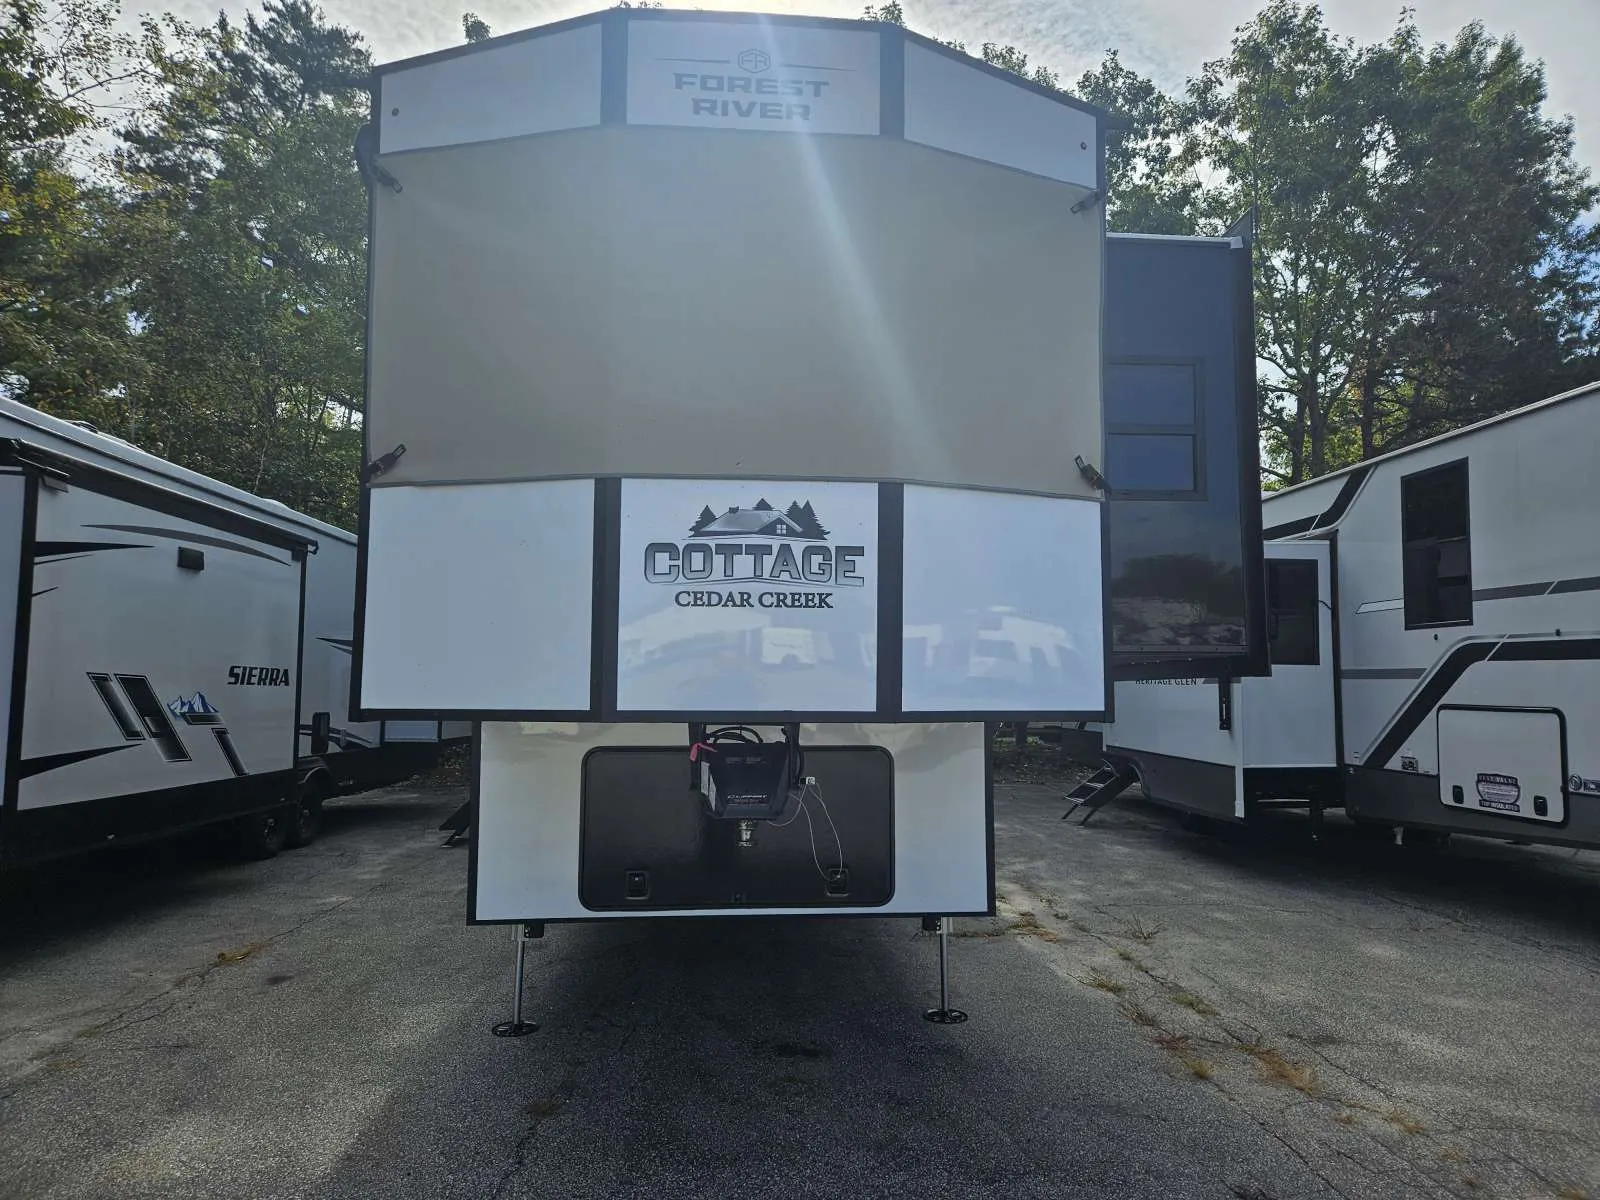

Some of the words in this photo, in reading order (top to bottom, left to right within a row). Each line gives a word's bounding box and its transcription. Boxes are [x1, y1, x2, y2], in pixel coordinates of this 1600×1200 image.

[672, 73, 829, 97] FOREST
[692, 98, 811, 120] RIVER
[644, 542, 865, 587] COTTAGE
[675, 590, 754, 608] CEDAR
[758, 591, 833, 609] CREEK
[227, 666, 289, 686] SIERRA
[1174, 677, 1197, 686] GLEN
